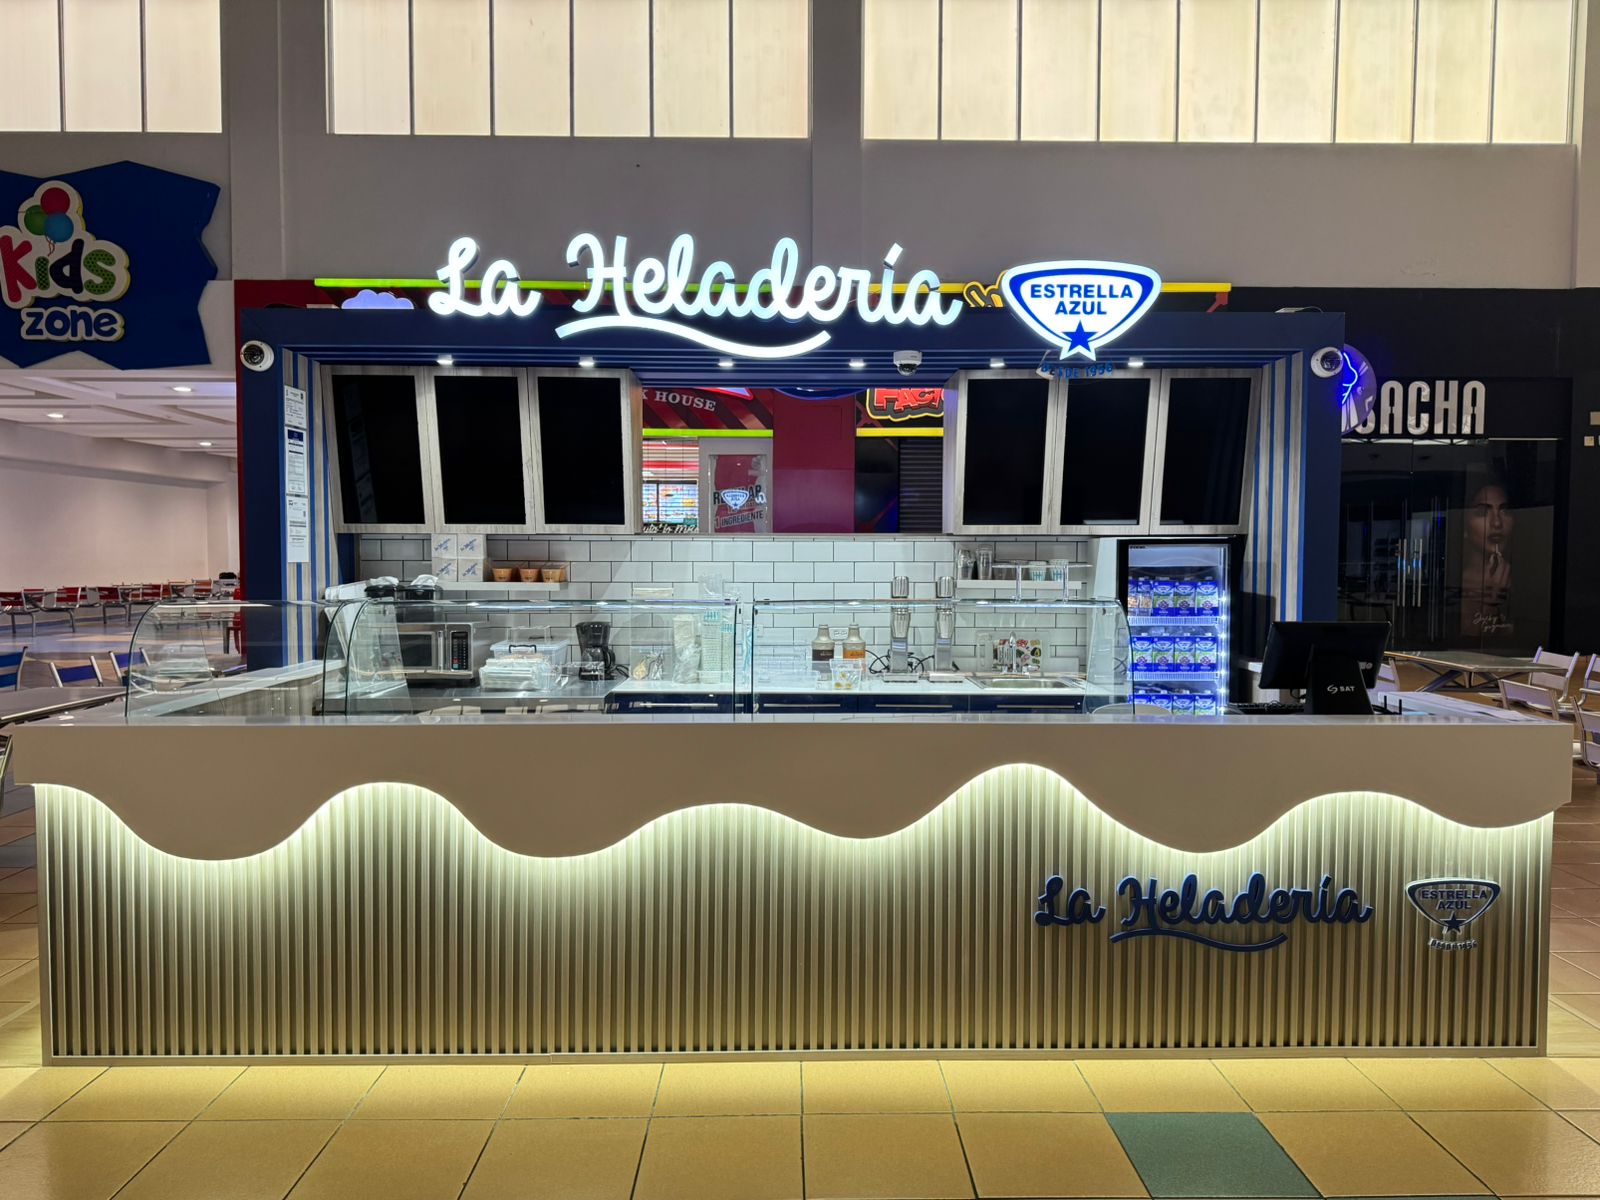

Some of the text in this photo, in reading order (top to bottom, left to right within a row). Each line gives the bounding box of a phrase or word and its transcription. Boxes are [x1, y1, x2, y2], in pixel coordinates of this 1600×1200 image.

[0, 235, 117, 303] Kids
[428, 232, 964, 359] La Heladería
[1030, 283, 1134, 300] ESTRELLA
[1055, 301, 1107, 315] AZUL
[25, 309, 119, 338] zone
[653, 390, 717, 412] HOUSE
[1421, 888, 1489, 900] ESTRELLA
[1034, 872, 1374, 952] La Heladería
[1436, 900, 1472, 911] AZUL
